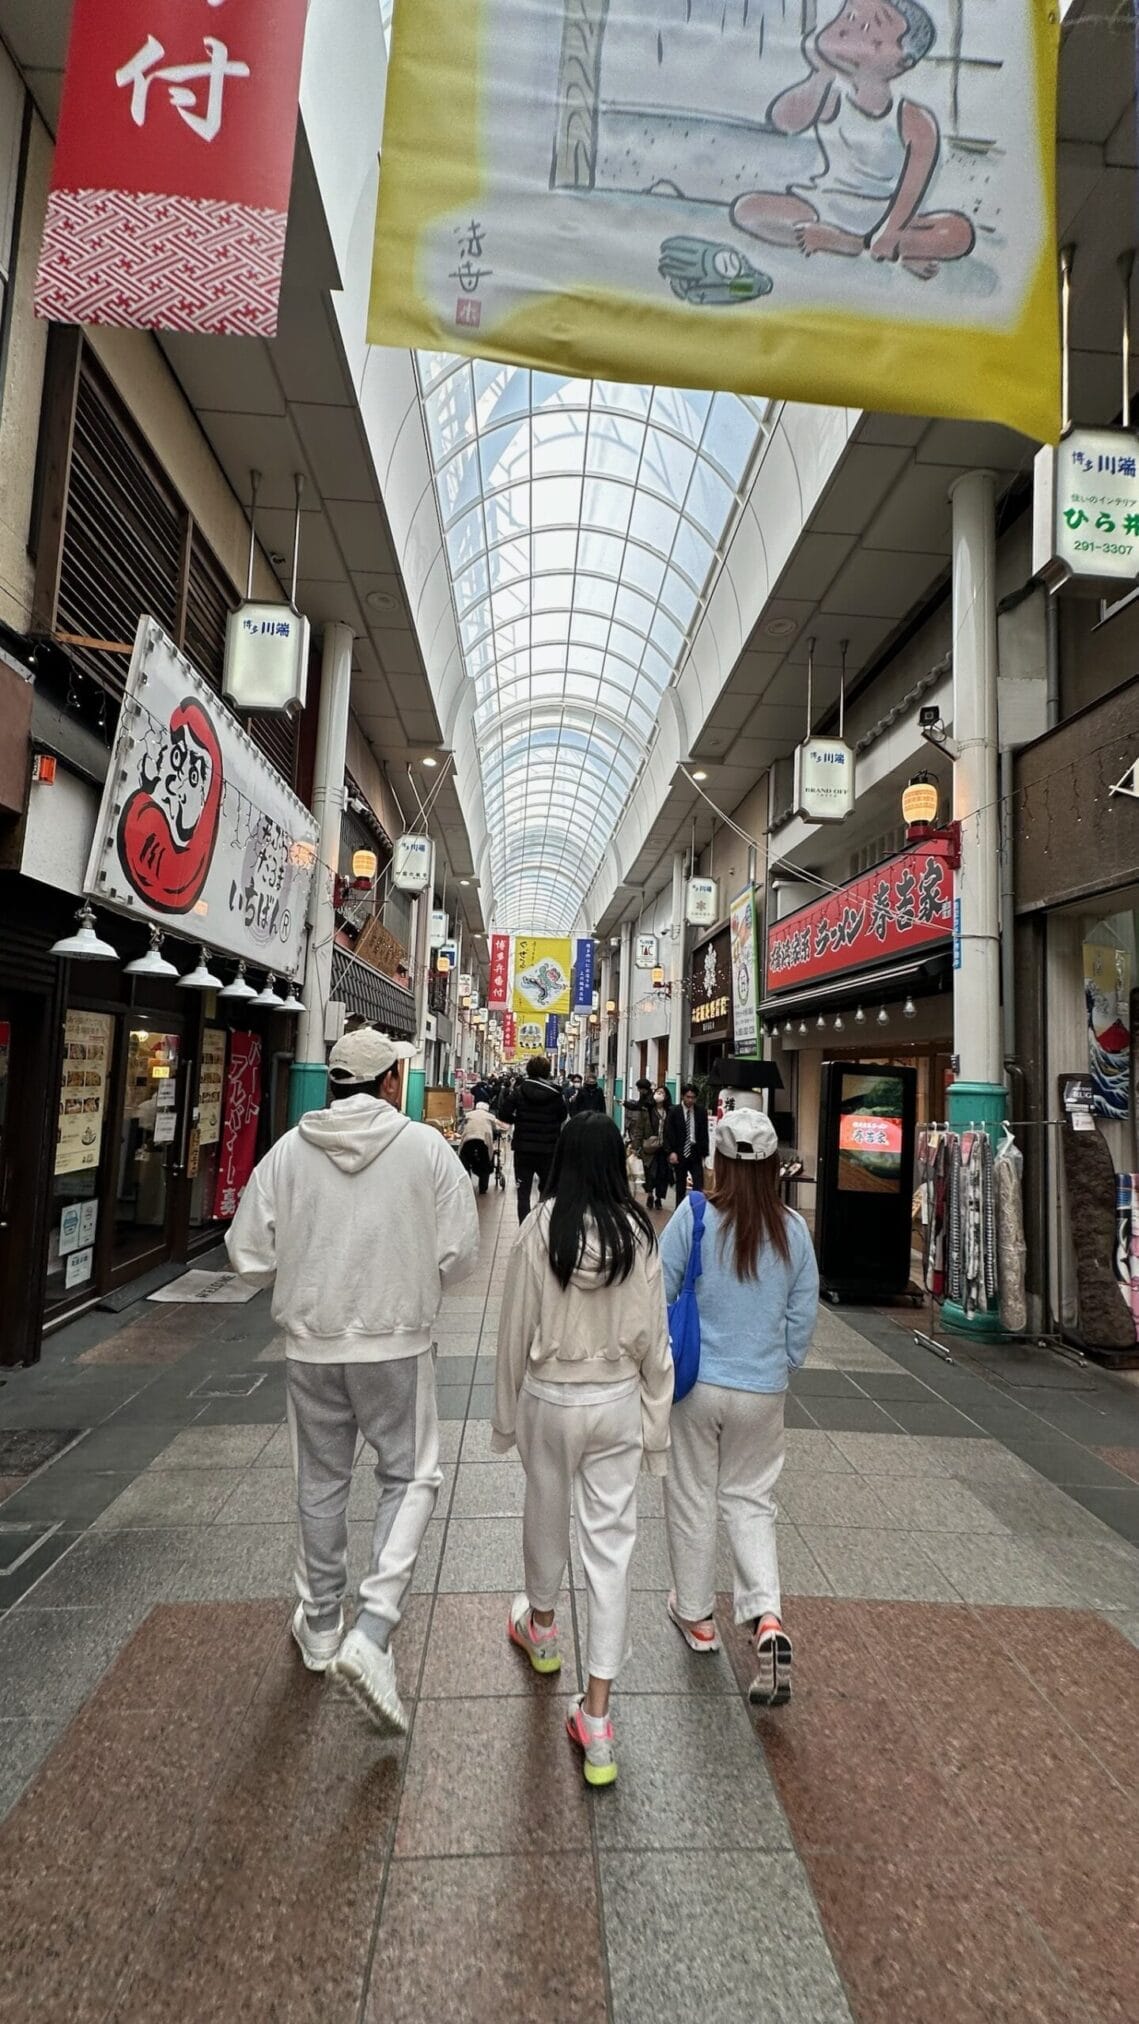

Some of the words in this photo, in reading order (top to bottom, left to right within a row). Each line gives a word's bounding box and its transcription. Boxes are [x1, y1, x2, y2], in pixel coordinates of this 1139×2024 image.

[1072, 451, 1136, 477] 博多川端
[1074, 540, 1134, 556] 291-3307
[243, 619, 290, 638] 博多川端
[229, 879, 280, 936] いちばん
